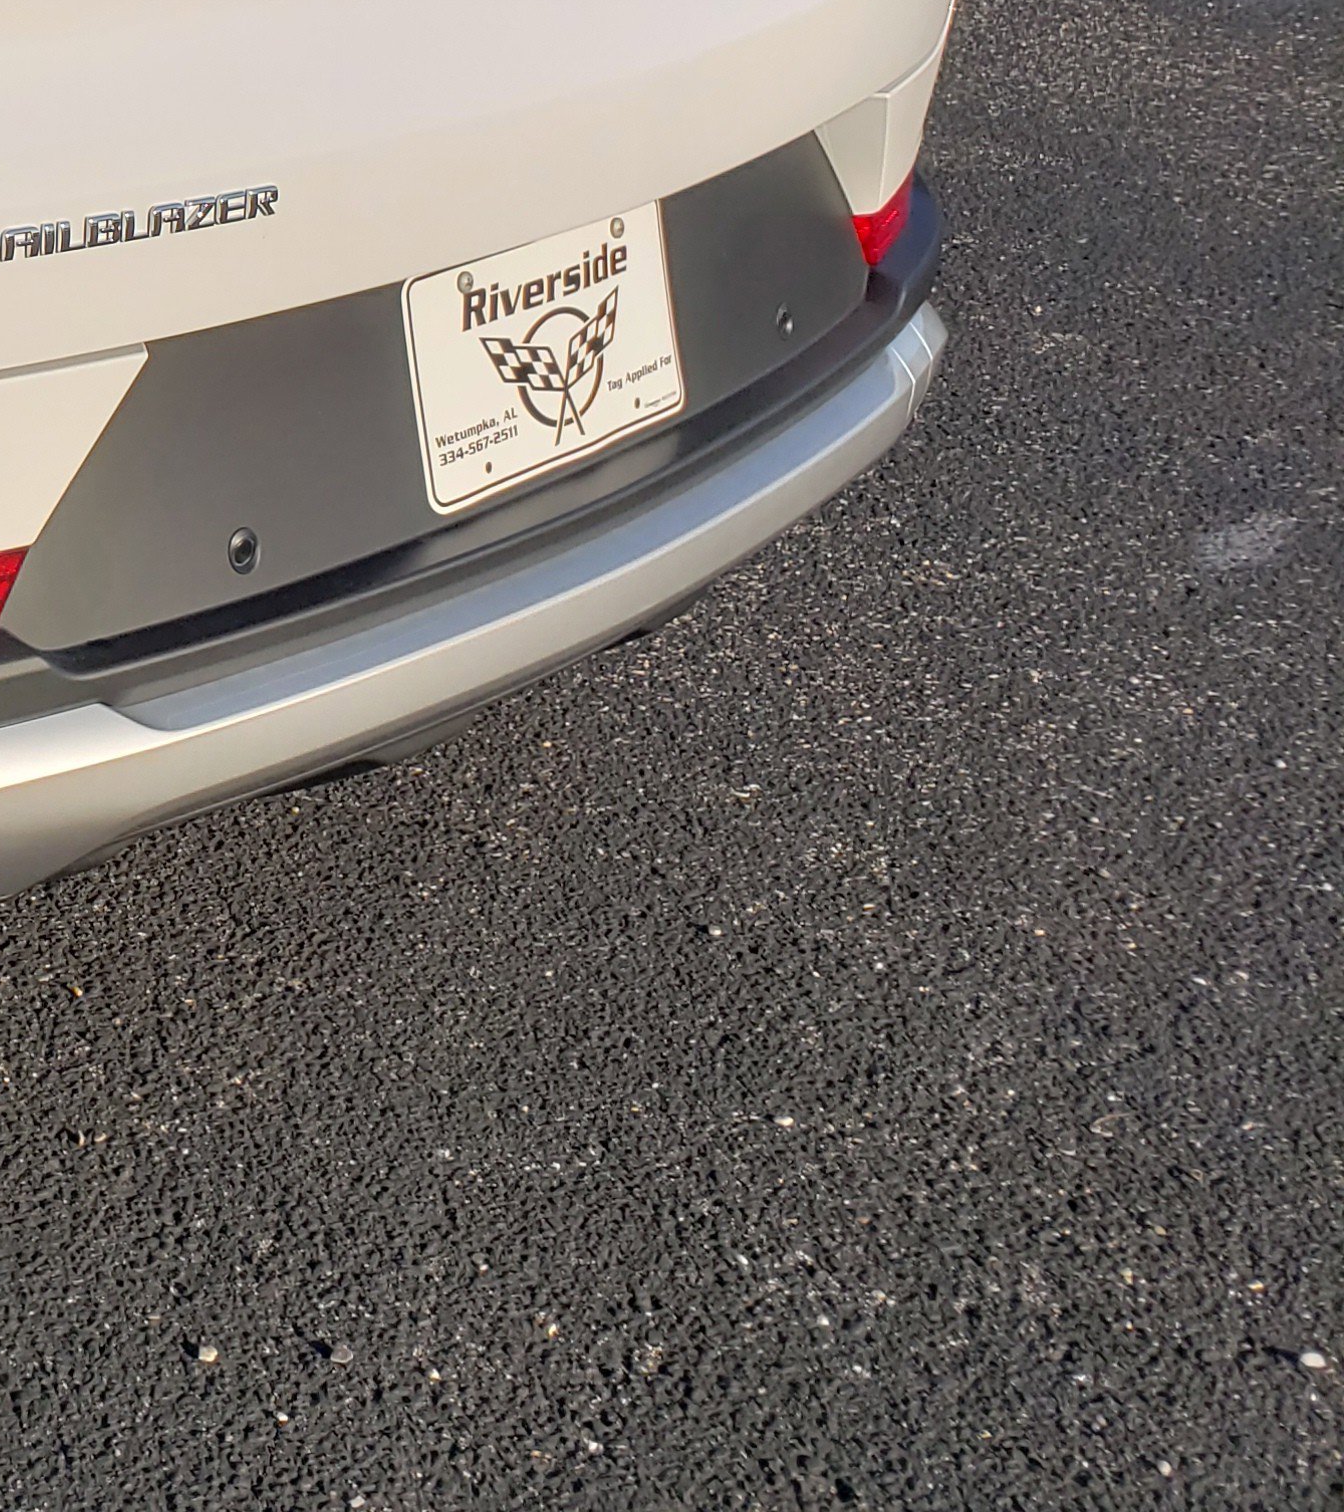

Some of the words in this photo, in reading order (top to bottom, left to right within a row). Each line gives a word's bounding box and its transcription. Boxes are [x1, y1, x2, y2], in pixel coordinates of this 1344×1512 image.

[462, 242, 627, 332] Riverside
[607, 377, 623, 392] Tag
[625, 359, 658, 384] Applied
[659, 354, 672, 368] For
[435, 418, 499, 449] Wetumpka,
[503, 407, 518, 423] AL
[438, 424, 518, 467] 334-567-2511
